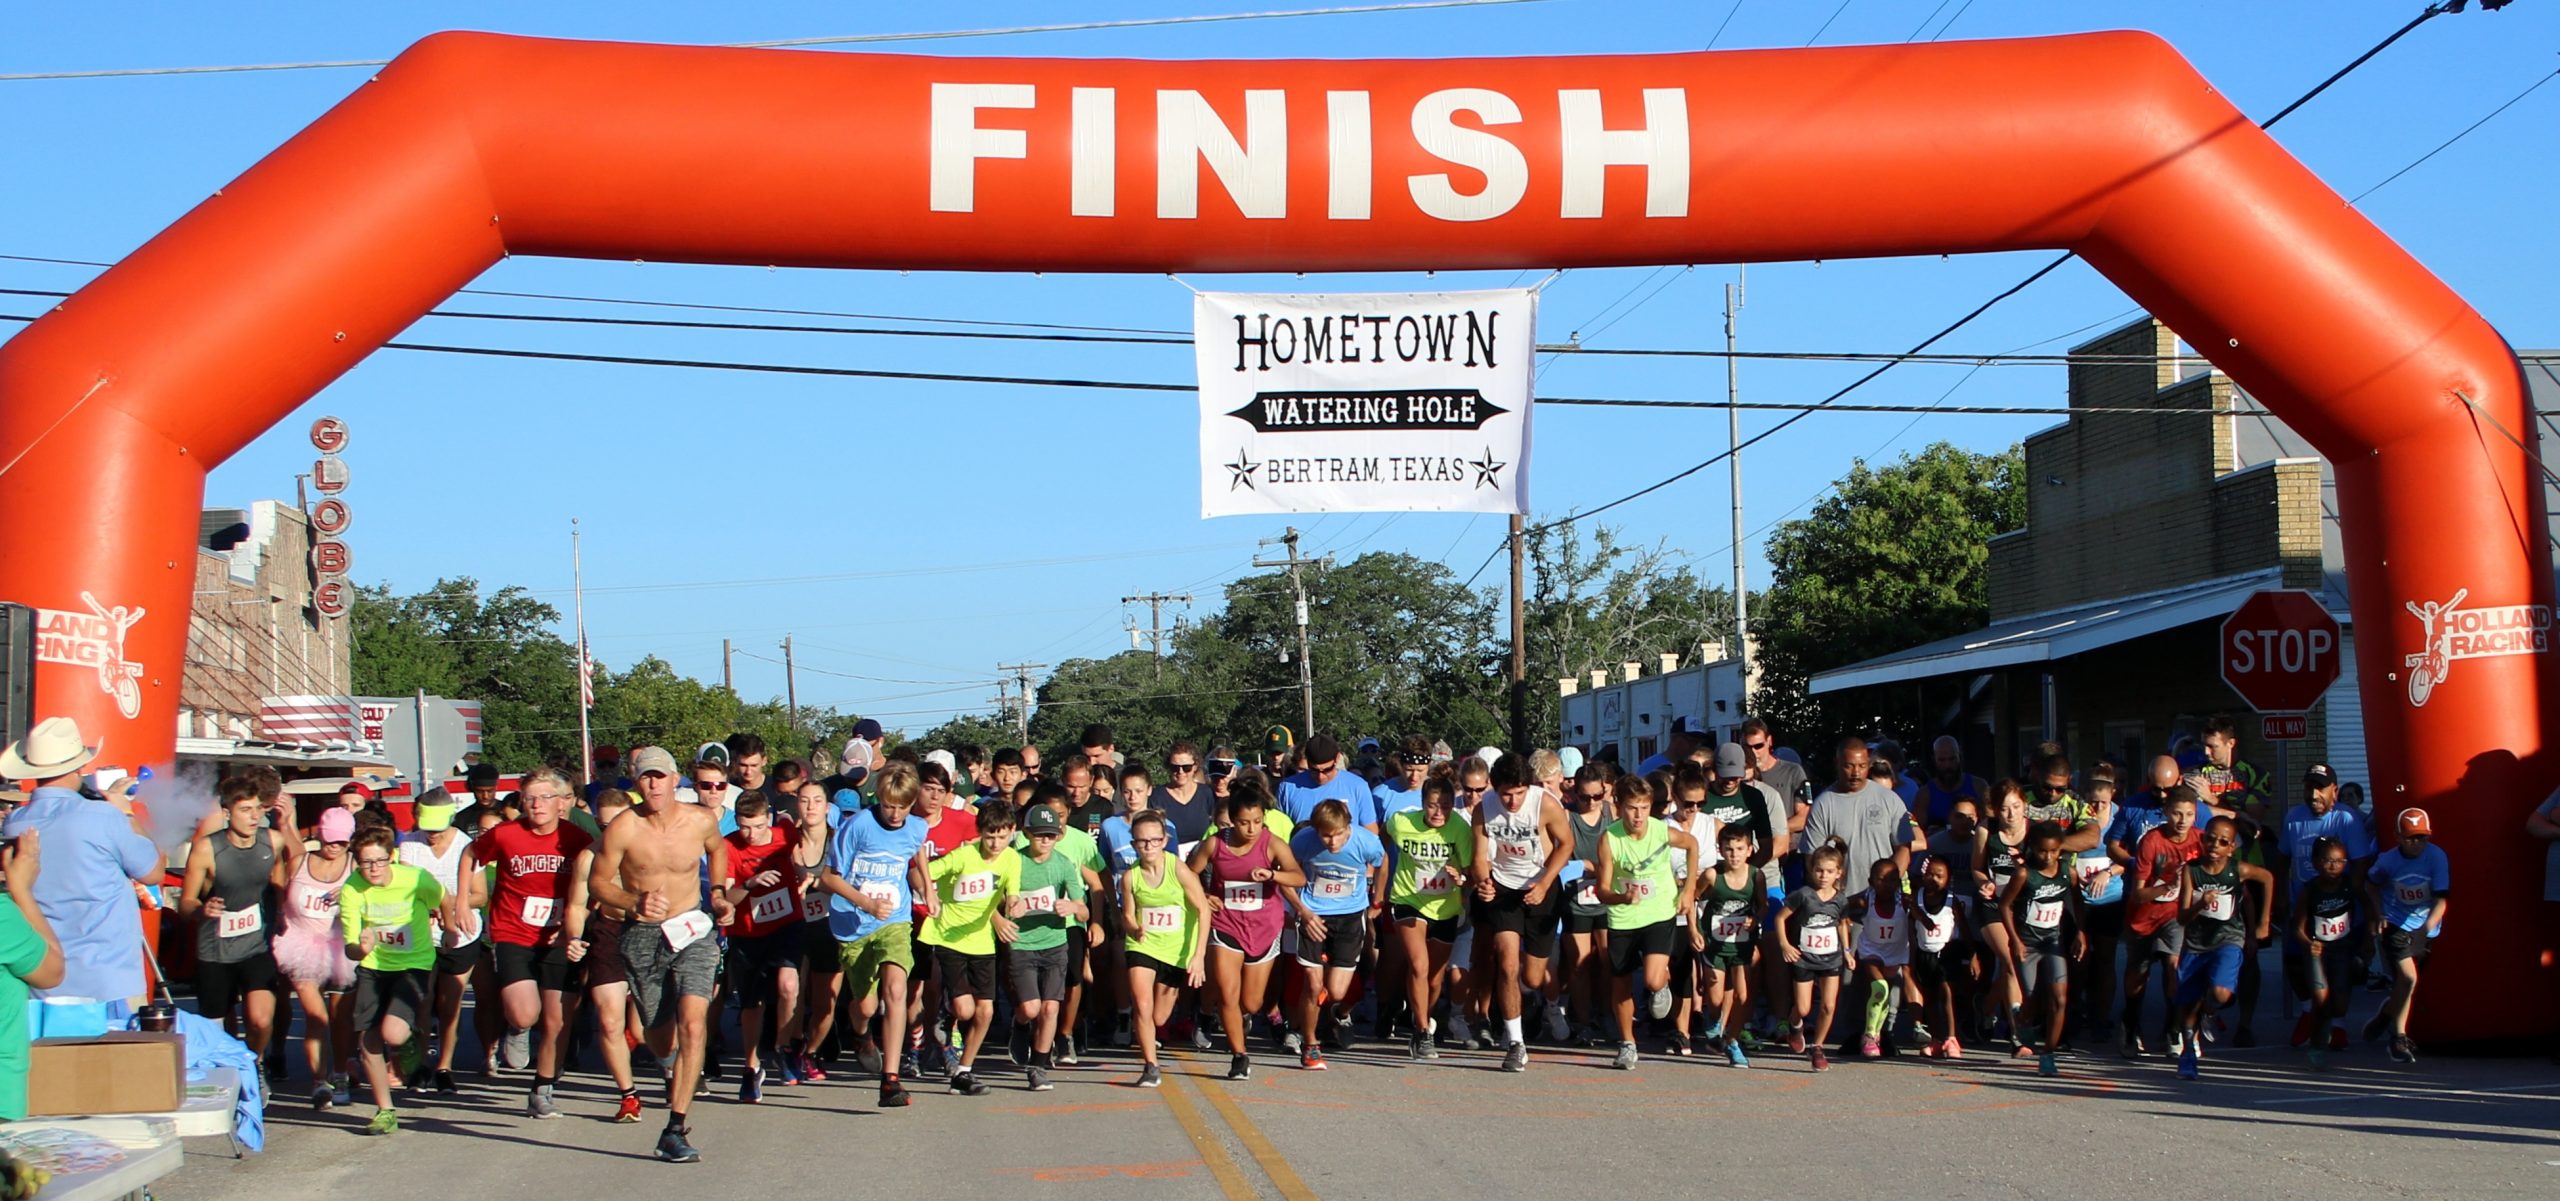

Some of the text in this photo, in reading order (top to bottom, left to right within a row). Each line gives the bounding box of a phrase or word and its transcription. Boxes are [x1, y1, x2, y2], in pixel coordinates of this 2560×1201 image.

[930, 83, 1689, 221] FINISH
[1233, 310, 1500, 372] HOMETOWN
[1262, 395, 1476, 425] WATERING HOLE
[1389, 456, 1464, 482] TEXAS
[311, 419, 346, 615] GLOBE
[2443, 607, 2550, 634] HOLLAND
[2450, 629, 2545, 656] RACING
[2231, 629, 2332, 673] STOP
[2265, 718, 2306, 735] ALL WAY
[1503, 844, 1526, 857] 145
[960, 879, 986, 895] 163
[1325, 883, 1342, 894] 69
[1422, 878, 1446, 890] 144
[1231, 888, 1256, 903] 165
[2399, 888, 2424, 900] 196
[758, 896, 785, 916] 111
[806, 900, 824, 916] 55
[1024, 895, 1051, 911] 179
[228, 913, 256, 932] 180
[1148, 911, 1173, 926] 171
[2034, 909, 2058, 922] 116
[684, 920, 697, 938] 1
[1718, 922, 1744, 936] 127
[1879, 926, 1895, 939] 17
[2321, 921, 2346, 936] 148
[377, 930, 405, 946] 154
[1806, 934, 1832, 948] 126
